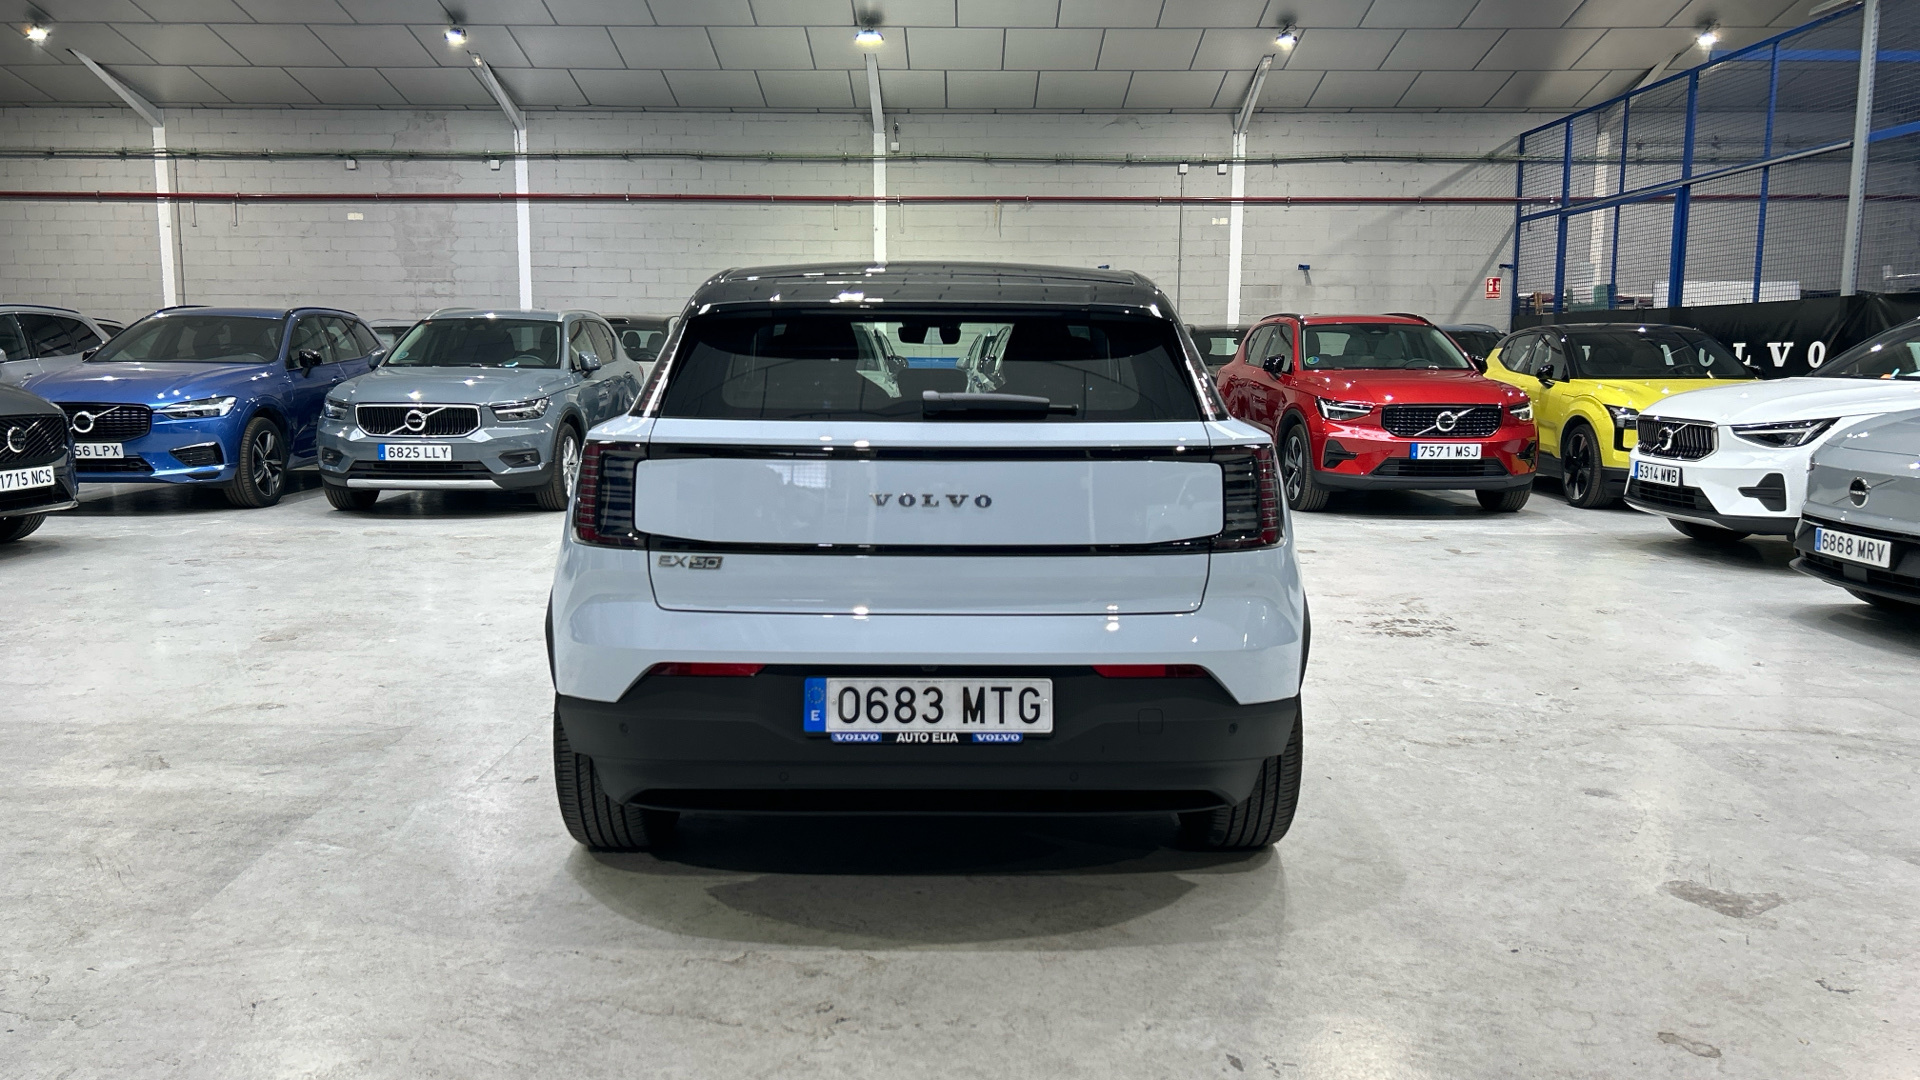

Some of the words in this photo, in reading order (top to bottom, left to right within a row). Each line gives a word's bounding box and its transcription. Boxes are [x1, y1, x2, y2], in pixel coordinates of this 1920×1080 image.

[94, 445, 119, 456] LPX
[388, 447, 420, 458] 6825
[424, 447, 448, 458] LLY
[1421, 446, 1450, 457] 7571
[1456, 446, 1478, 457] MSJ
[1640, 465, 1658, 480] 5314
[0, 471, 28, 489] 1715
[31, 469, 51, 485] NCS
[870, 494, 992, 508] VOLVO
[1822, 532, 1853, 555] 6868
[1857, 539, 1885, 561] MRV
[811, 710, 820, 721] E
[838, 686, 944, 724] 0683
[963, 686, 1041, 724] MTG
[835, 733, 879, 741] VOLVO
[896, 732, 929, 743] AUTO
[932, 732, 959, 743] ELIA
[976, 733, 1020, 741] VOLVO
